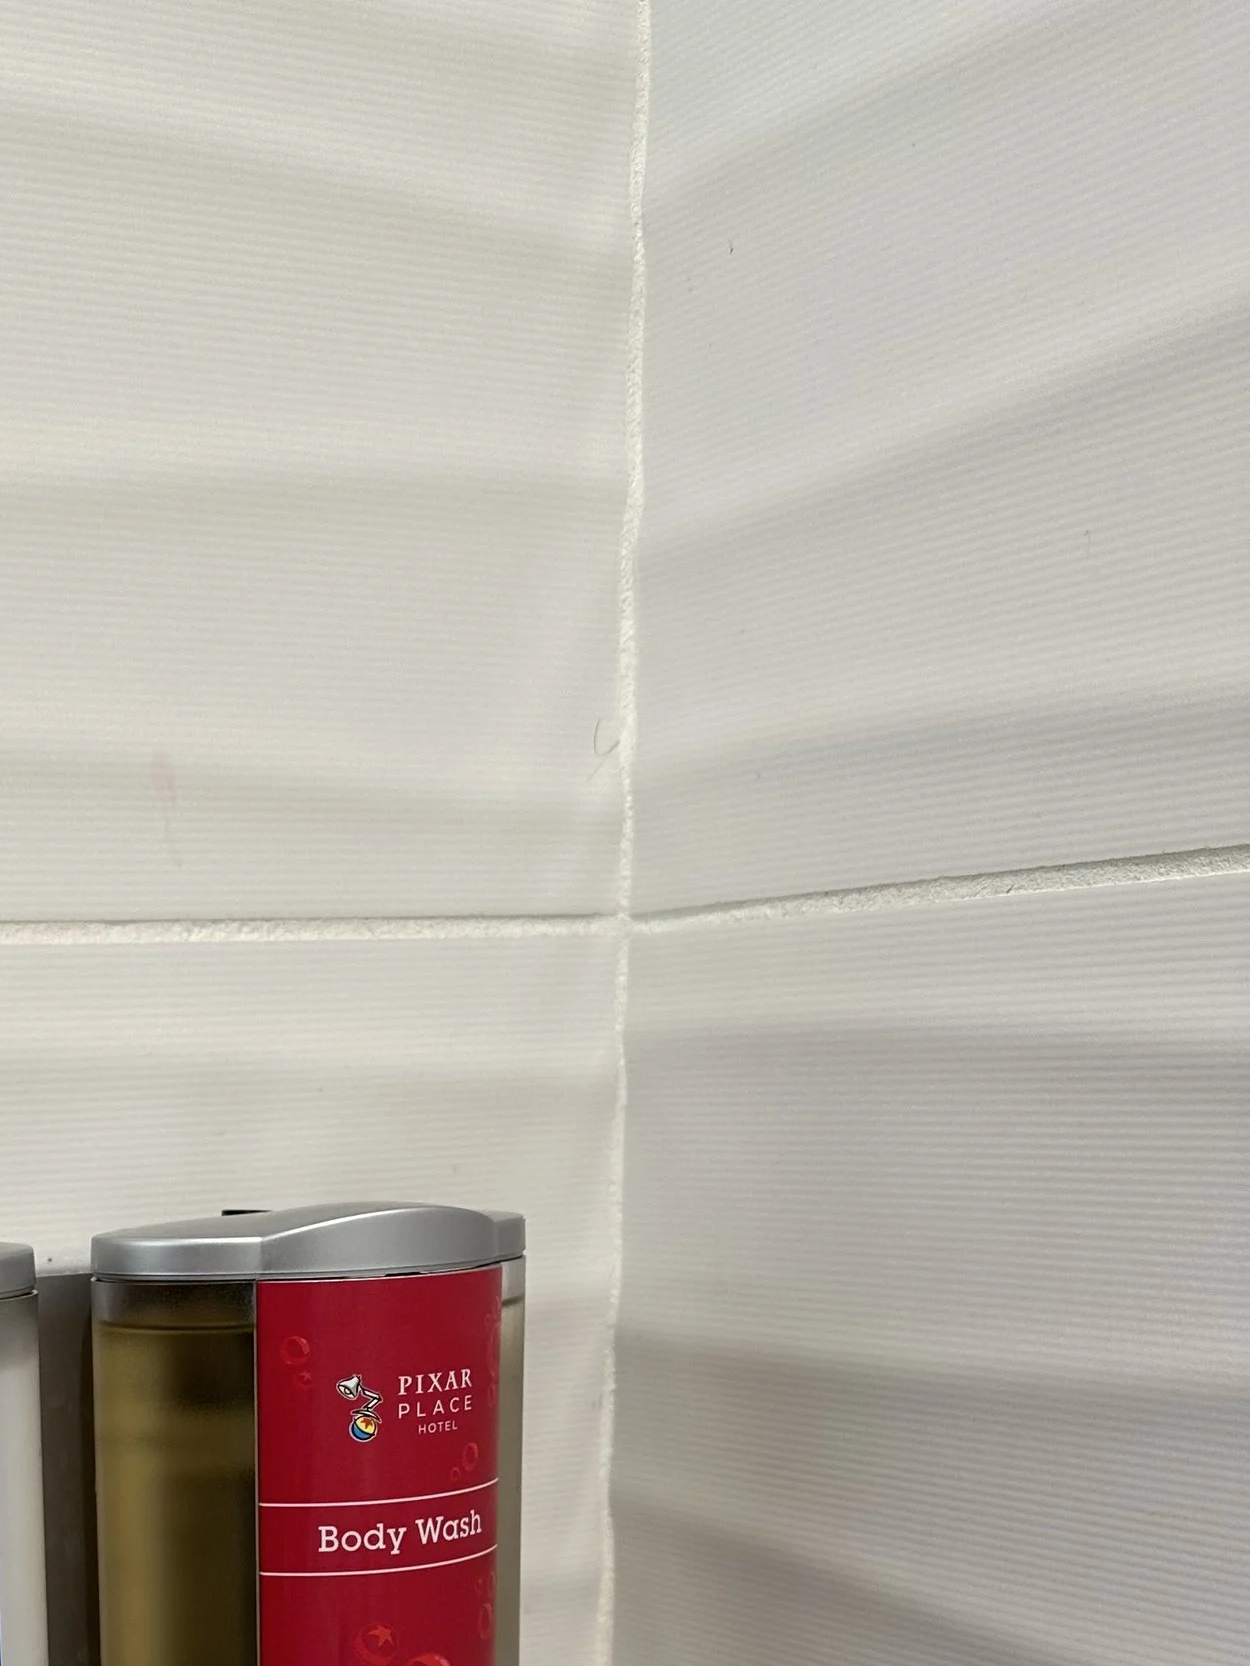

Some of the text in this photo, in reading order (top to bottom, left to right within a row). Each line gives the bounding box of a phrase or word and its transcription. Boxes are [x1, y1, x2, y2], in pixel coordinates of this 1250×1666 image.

[398, 1369, 472, 1396] PIXAR
[398, 1395, 472, 1418] PLACE
[419, 1421, 458, 1434] HOTEL
[318, 1510, 482, 1555] Body Wash
